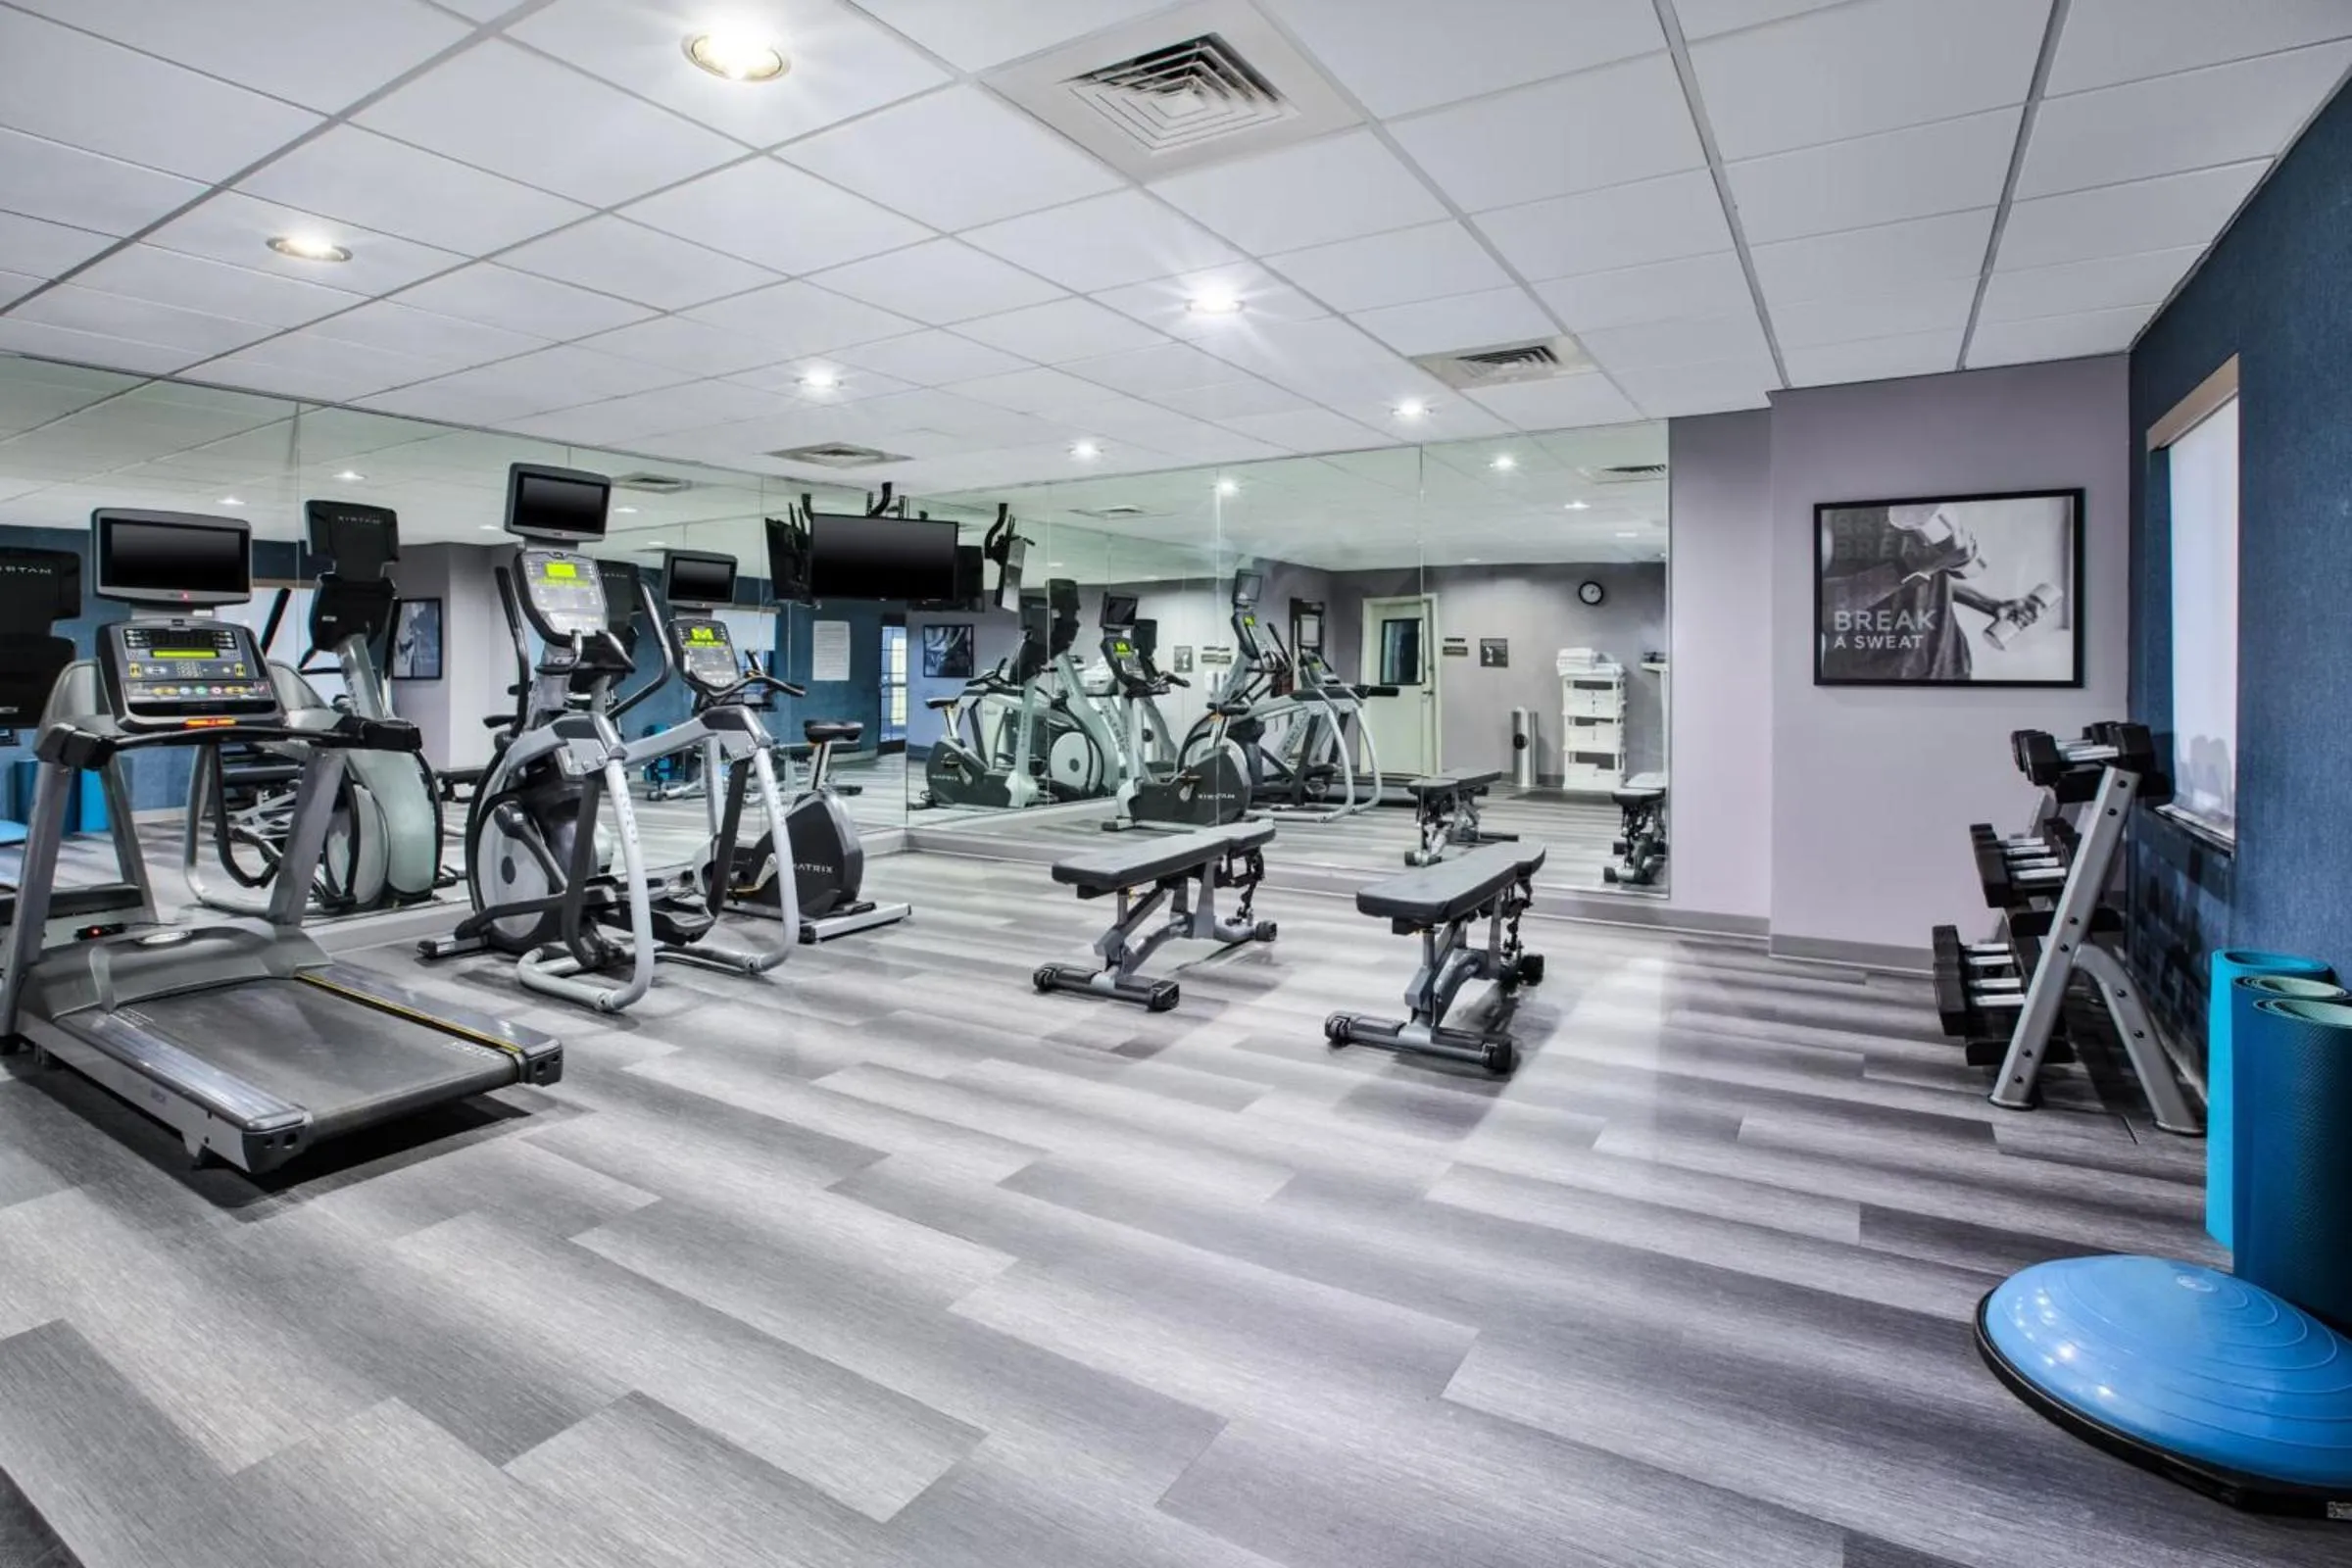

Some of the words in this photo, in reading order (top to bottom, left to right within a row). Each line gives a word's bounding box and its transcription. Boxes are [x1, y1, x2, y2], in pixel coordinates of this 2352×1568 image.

[1834, 610, 1936, 632] BREAK
[1834, 635, 1846, 649] A
[1854, 634, 1924, 649] SWEAT
